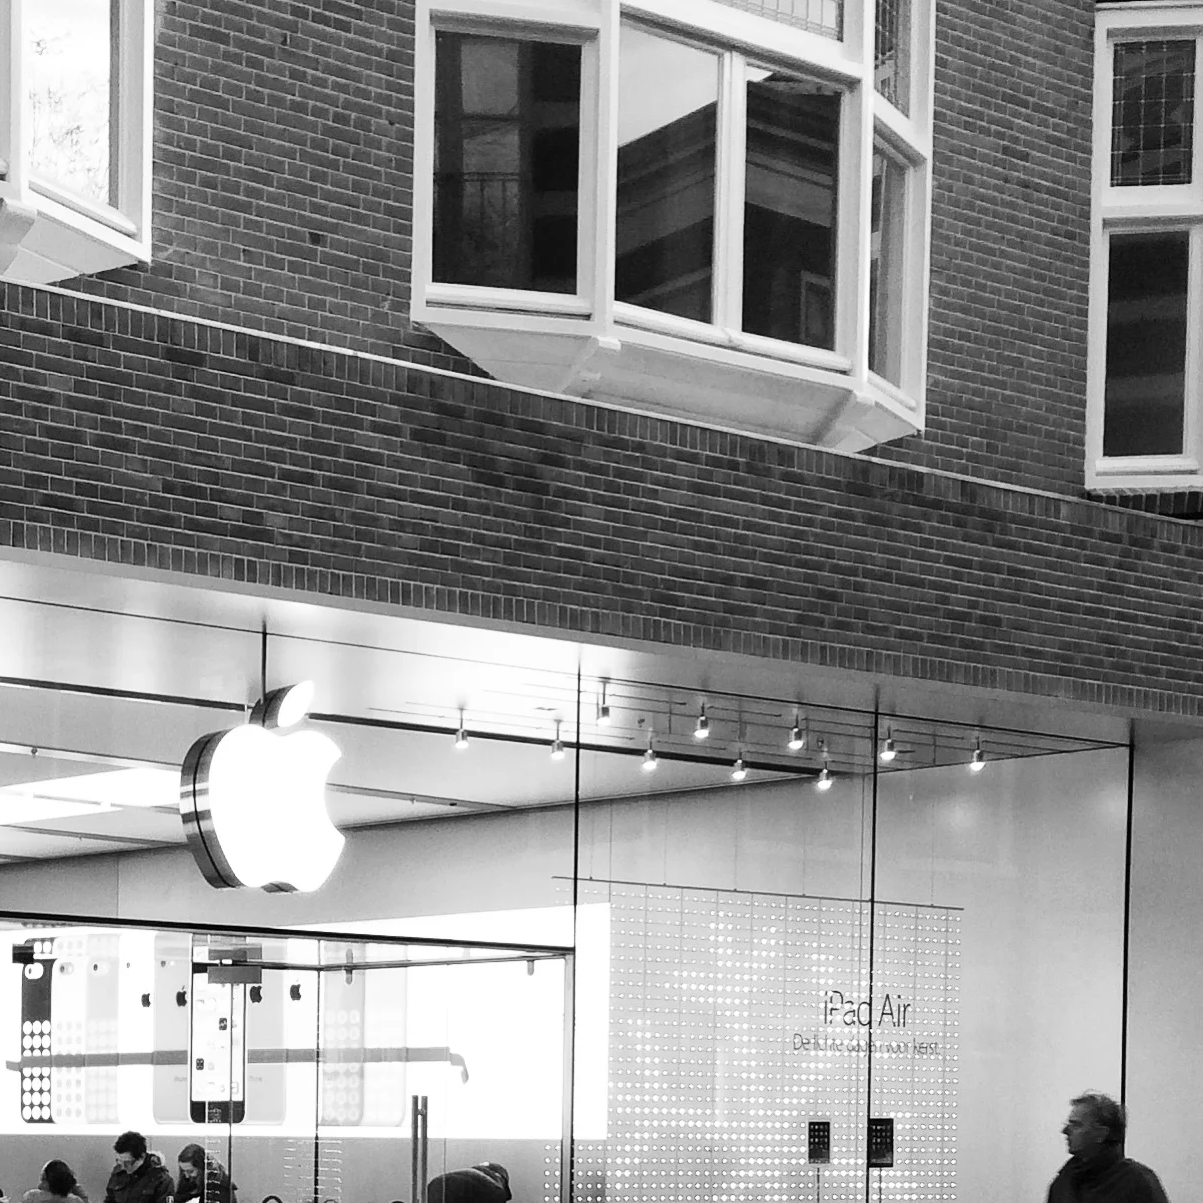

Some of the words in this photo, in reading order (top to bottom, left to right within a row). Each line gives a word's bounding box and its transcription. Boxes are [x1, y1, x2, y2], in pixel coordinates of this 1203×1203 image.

[824, 989, 873, 1027] iPad
[878, 993, 912, 1028] Air
[793, 1033, 810, 1051] De
